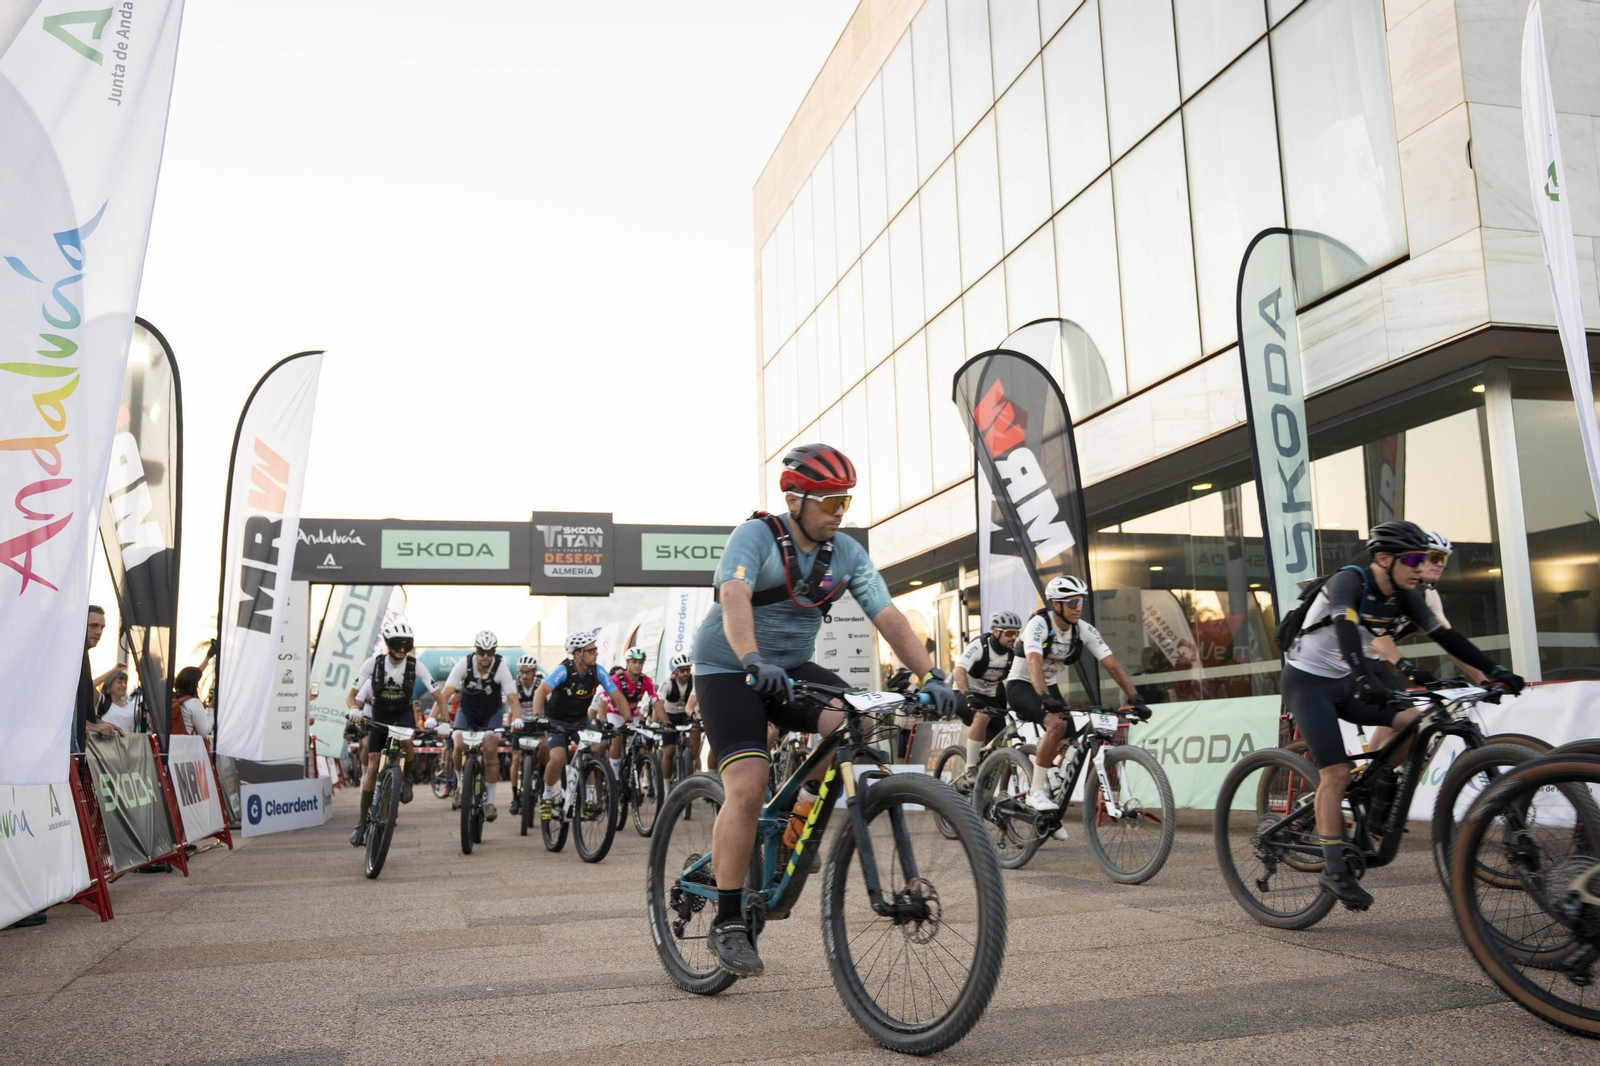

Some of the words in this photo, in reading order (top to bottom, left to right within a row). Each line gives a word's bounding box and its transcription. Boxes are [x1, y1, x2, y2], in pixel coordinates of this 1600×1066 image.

[108, 63, 126, 106] Junta
[117, 41, 129, 62] de
[0, 197, 110, 597] Andalucía
[237, 437, 291, 635] MRW
[297, 528, 367, 547] Andalucía
[535, 524, 604, 549] TITAN
[562, 526, 604, 535] SKODA
[544, 553, 603, 564] DESERT
[655, 545, 725, 559] SKOD
[552, 566, 594, 575] ALMERÍA
[674, 593, 690, 653] Cleardent
[324, 585, 375, 691] SKOD
[861, 691, 882, 701] 75
[174, 759, 210, 808] MRW
[264, 795, 319, 817] Cleardent
